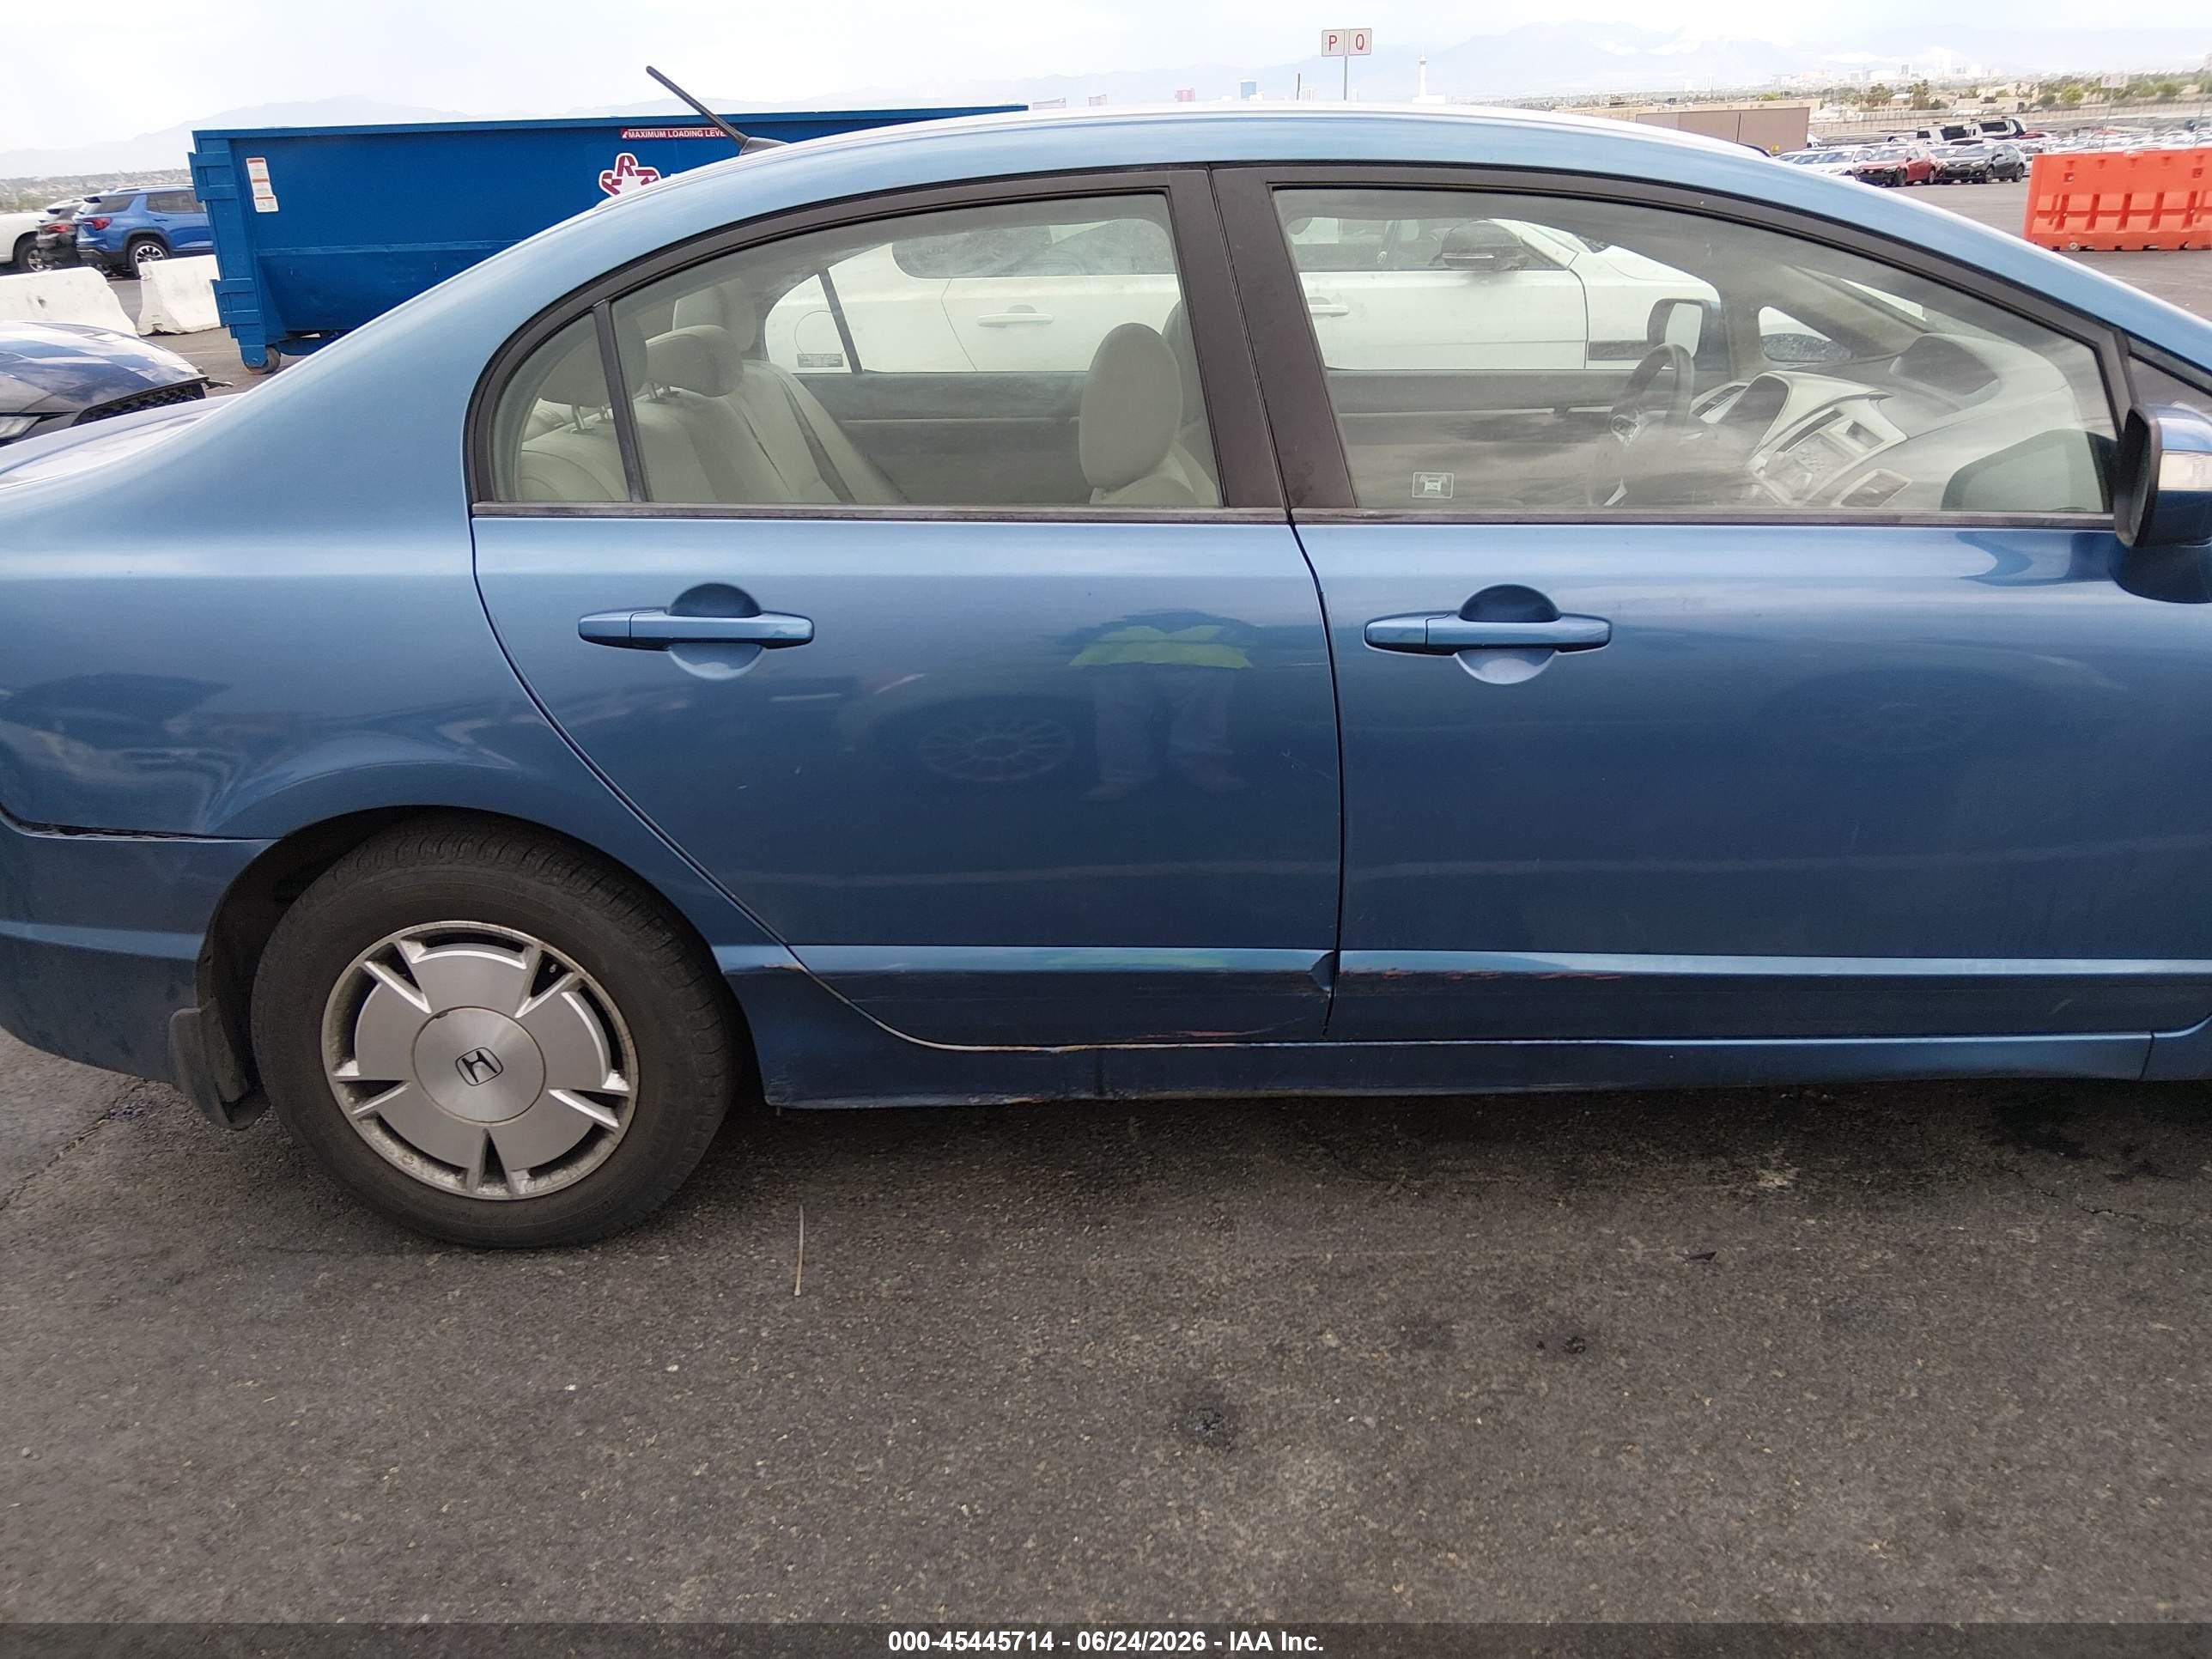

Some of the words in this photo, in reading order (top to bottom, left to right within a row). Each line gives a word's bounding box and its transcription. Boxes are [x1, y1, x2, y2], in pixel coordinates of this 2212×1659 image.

[1328, 34, 1338, 52] P
[1355, 33, 1365, 51] Q
[628, 130, 665, 138] MAXIMUM
